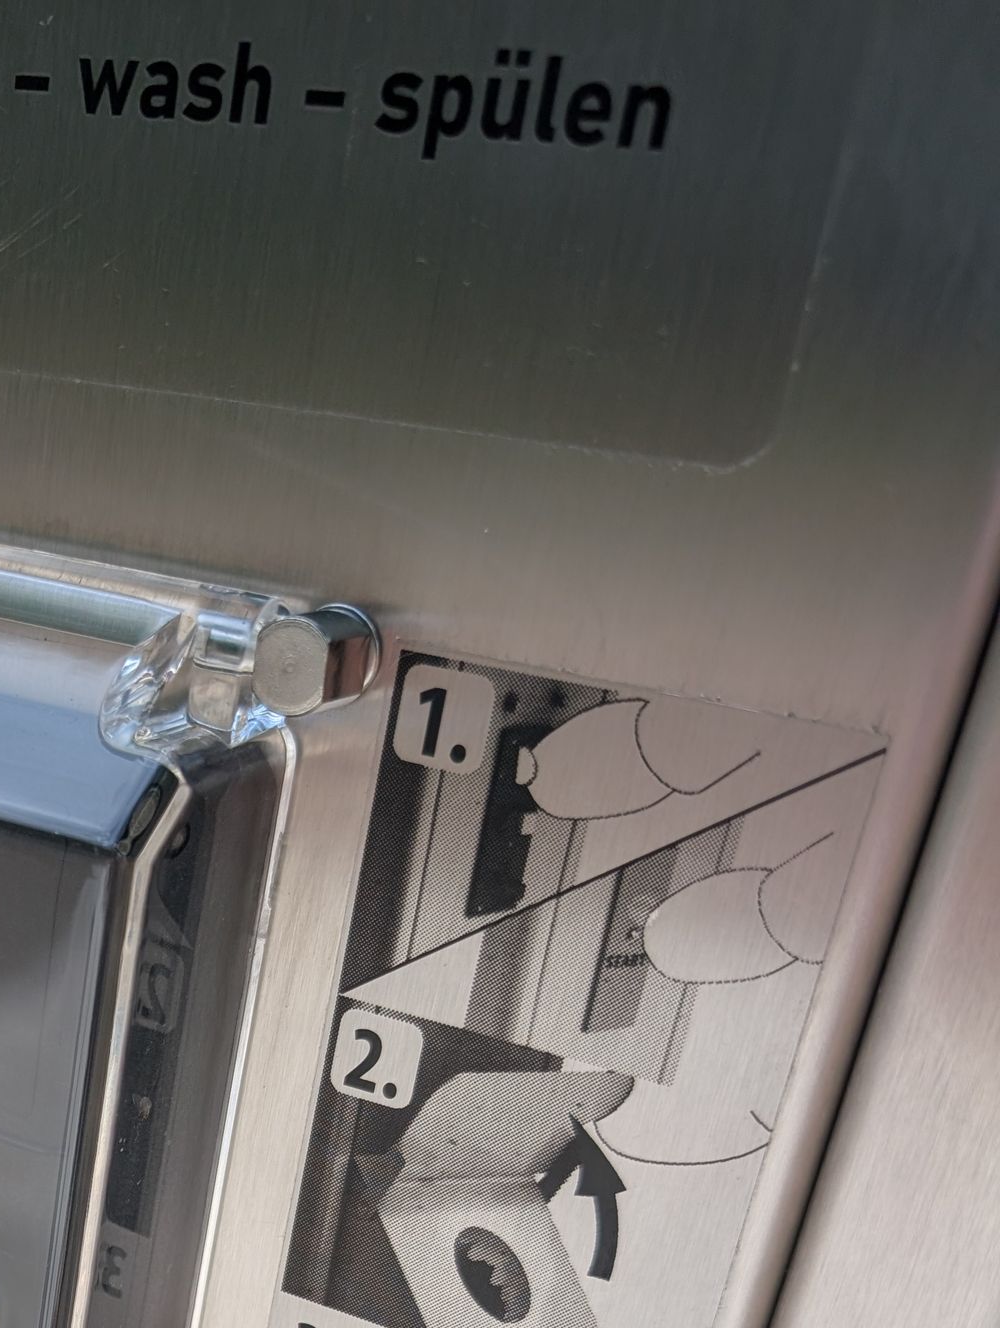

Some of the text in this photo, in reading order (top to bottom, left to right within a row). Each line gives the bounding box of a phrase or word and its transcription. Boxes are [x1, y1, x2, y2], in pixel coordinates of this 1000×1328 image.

[79, 41, 272, 125] wash
[374, 48, 672, 160] spülen
[419, 687, 467, 764] 1.
[342, 1028, 398, 1100] 2.
